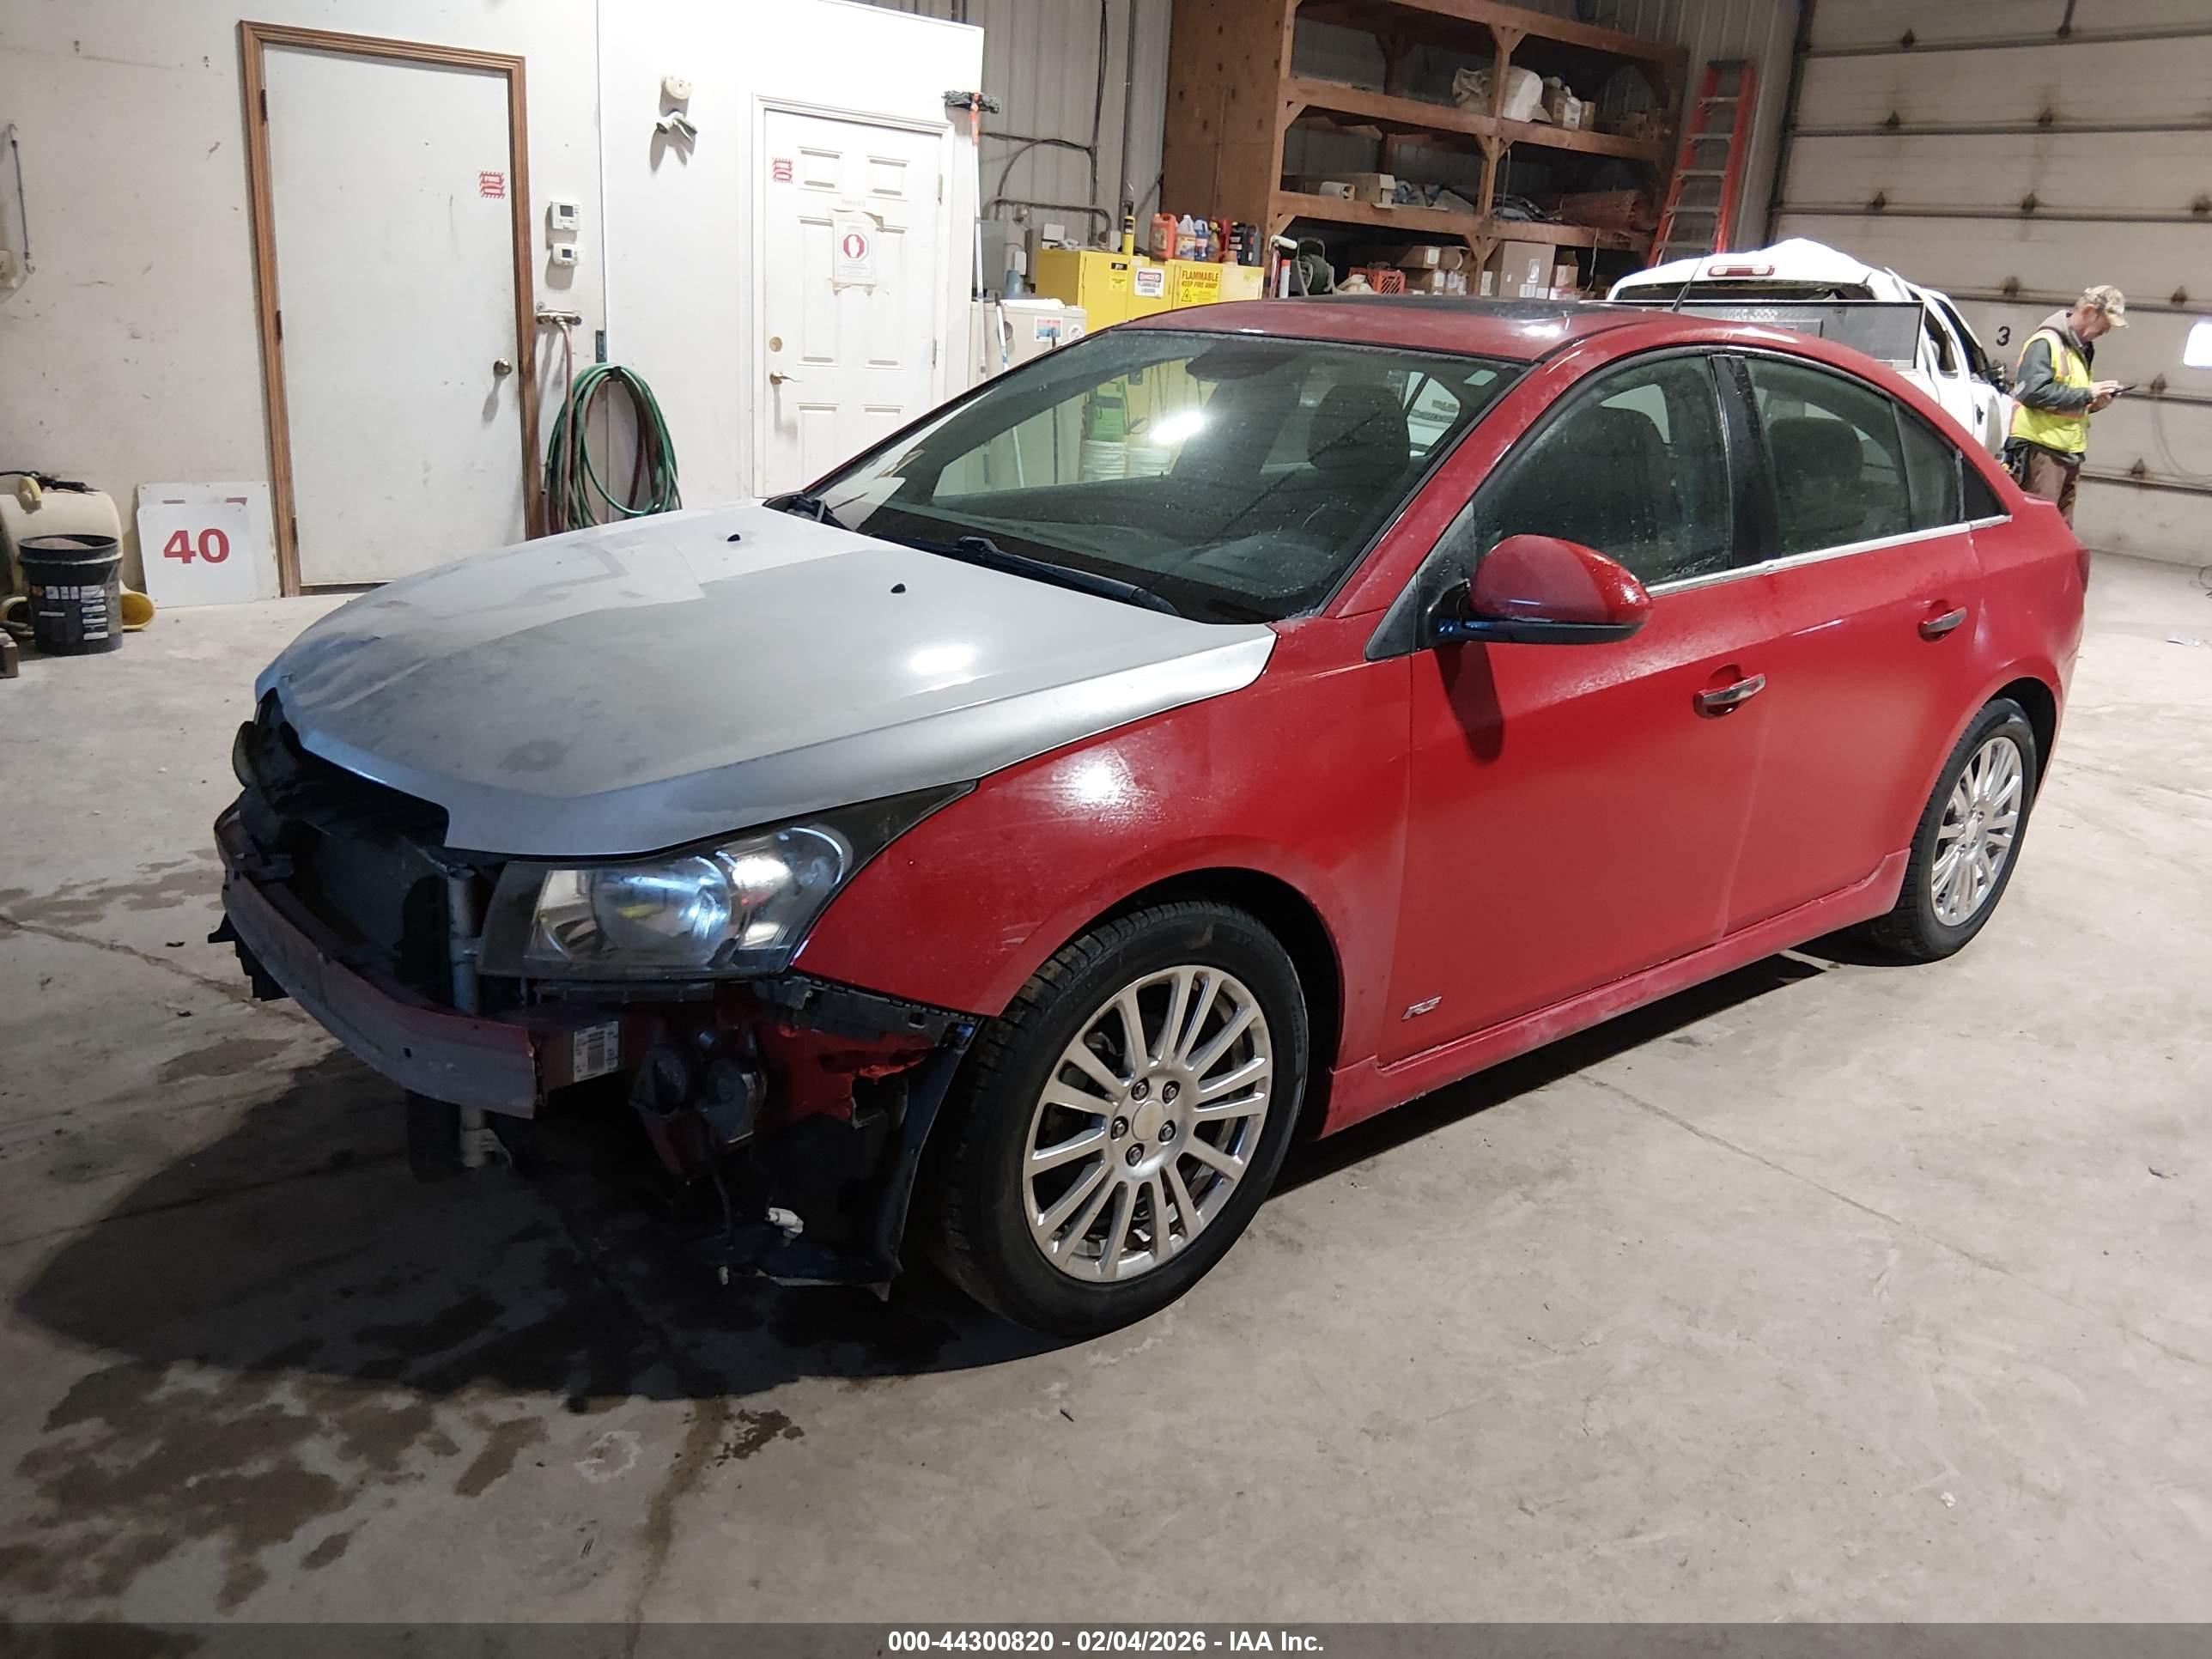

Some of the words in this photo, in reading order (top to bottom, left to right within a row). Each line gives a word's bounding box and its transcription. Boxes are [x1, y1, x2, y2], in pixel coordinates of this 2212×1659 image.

[1182, 270, 1219, 283] FLAMMABLE
[1996, 326, 2010, 346] 3
[163, 528, 230, 564] 40
